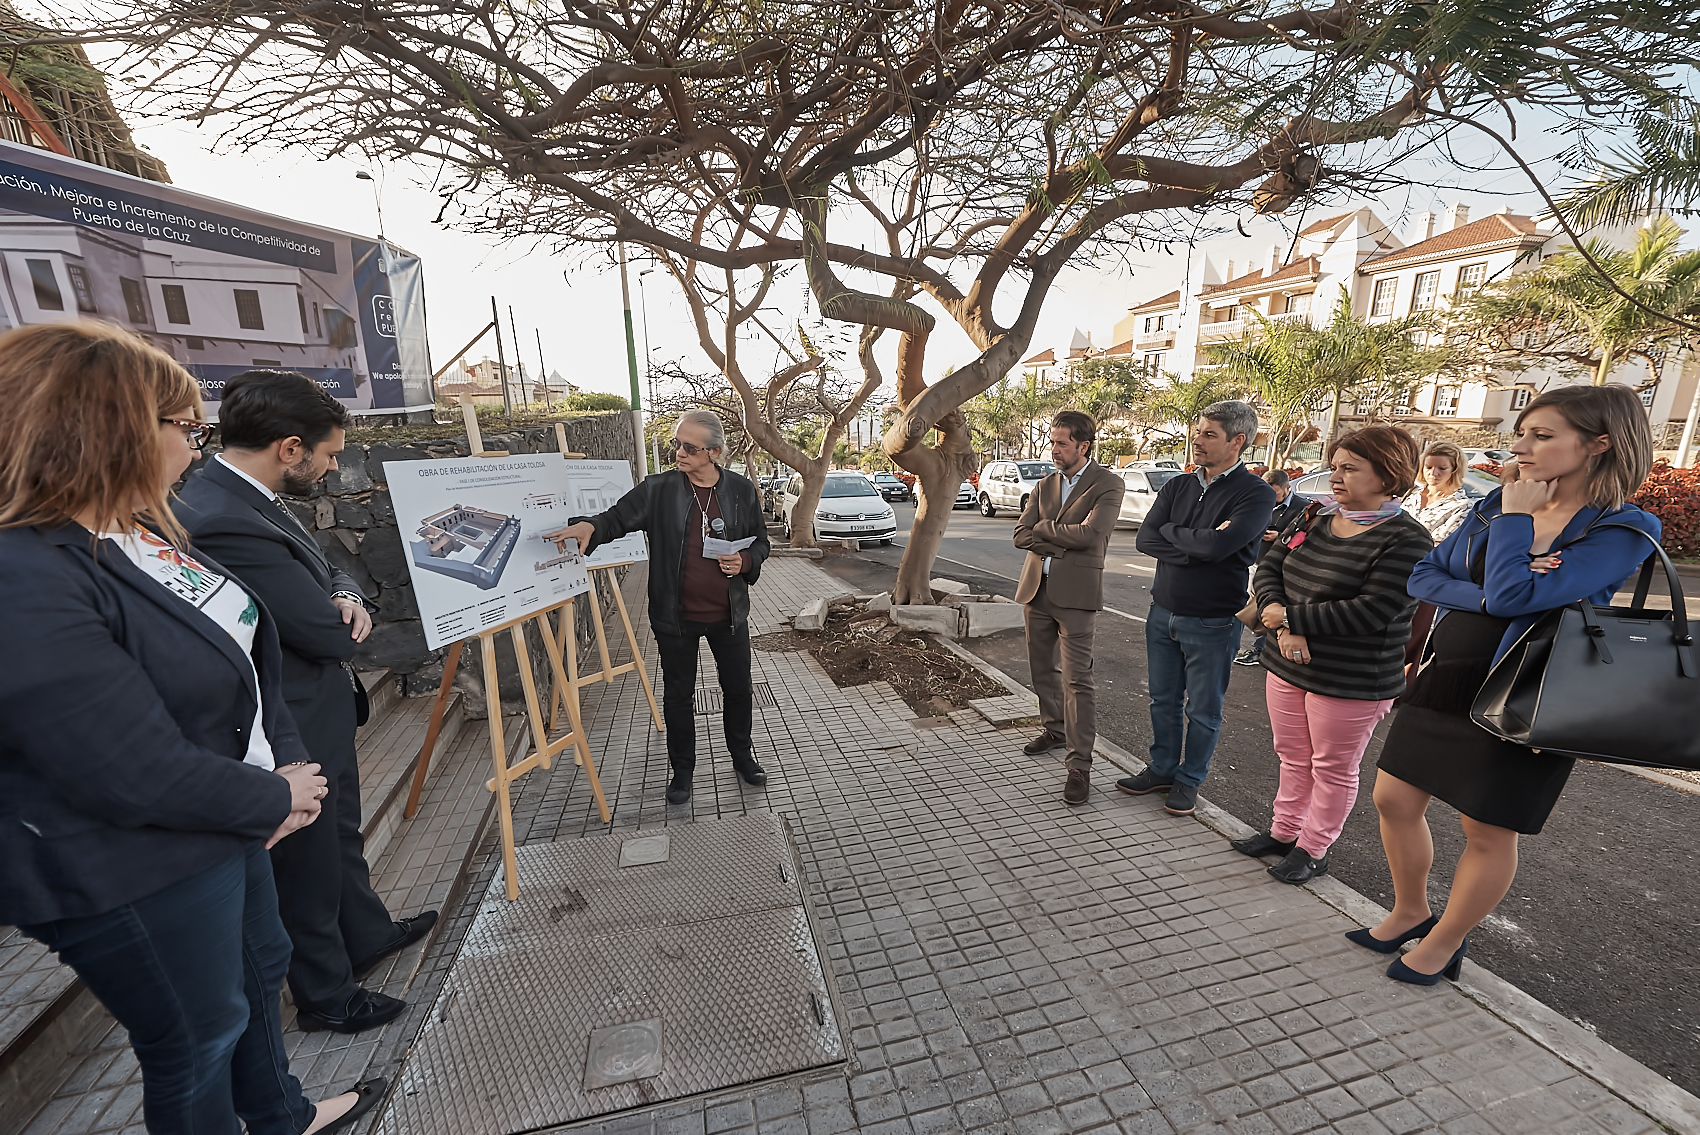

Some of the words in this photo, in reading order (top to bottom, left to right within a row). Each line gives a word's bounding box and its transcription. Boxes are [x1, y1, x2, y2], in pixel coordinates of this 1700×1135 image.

[50, 184, 104, 208] Mejora
[108, 200, 118, 210] e
[120, 200, 196, 228] Incremento
[199, 220, 215, 232] de
[218, 224, 228, 236] la
[231, 226, 307, 253] Competitividad
[308, 246, 321, 256] de
[72, 207, 122, 228] Puerto
[125, 220, 144, 233] de
[146, 222, 160, 236] la
[162, 226, 192, 243] Cruz
[313, 379, 340, 388] ación
[418, 468, 438, 477] OBRA
[440, 468, 448, 476] DE
[450, 464, 498, 474] REHABILITACIÓN
[158, 563, 180, 576] STO
